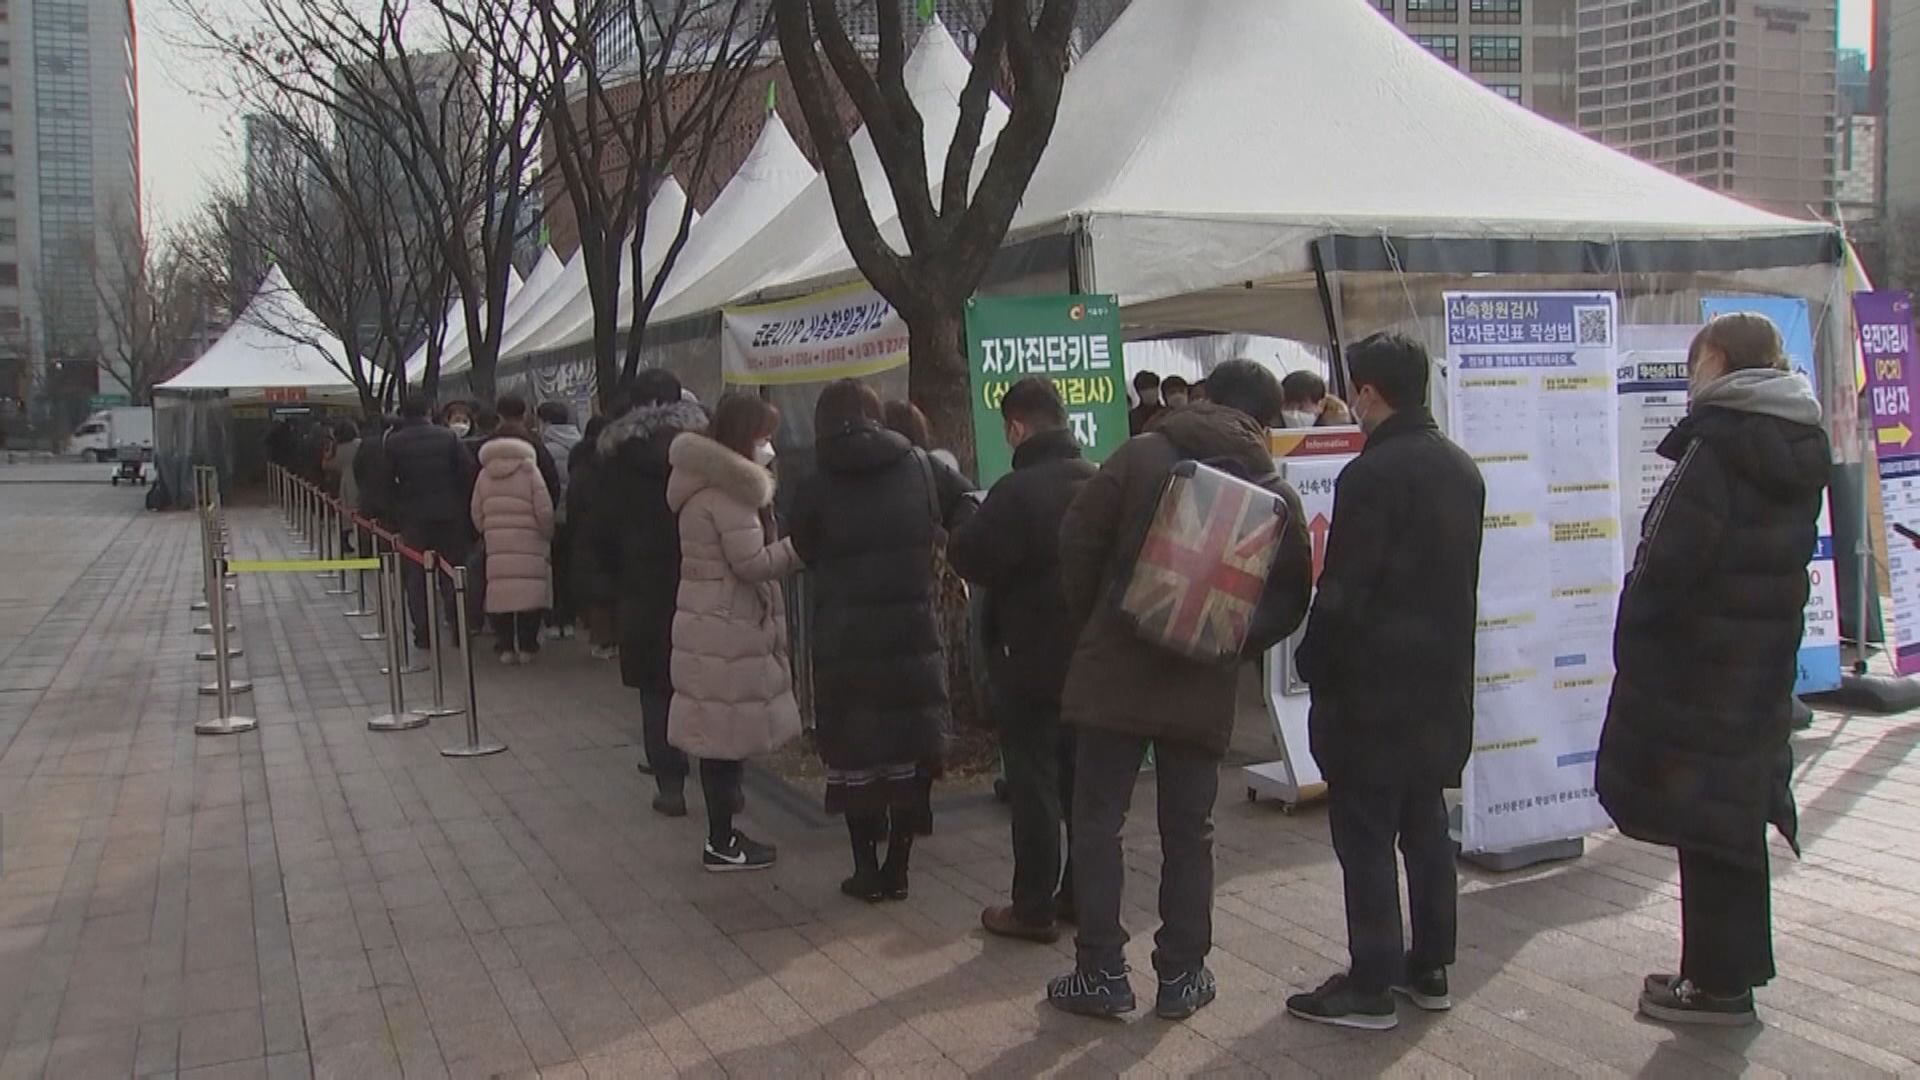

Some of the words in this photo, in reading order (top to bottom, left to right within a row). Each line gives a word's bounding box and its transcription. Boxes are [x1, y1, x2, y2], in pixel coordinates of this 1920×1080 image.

[1451, 300, 1539, 320] 신속항원검사
[752, 318, 805, 347] 코로나19
[1451, 323, 1524, 343] 전자문진표
[1530, 322, 1572, 342] 작성법
[1862, 324, 1909, 353] 유전자검사
[982, 334, 1112, 374] 자가진단키트
[1875, 358, 1901, 380] (PCR)
[983, 376, 1114, 409] (신원검사)
[1873, 386, 1910, 415] 대상자
[1305, 438, 1350, 449] Information
[1298, 478, 1338, 495] 신속항
